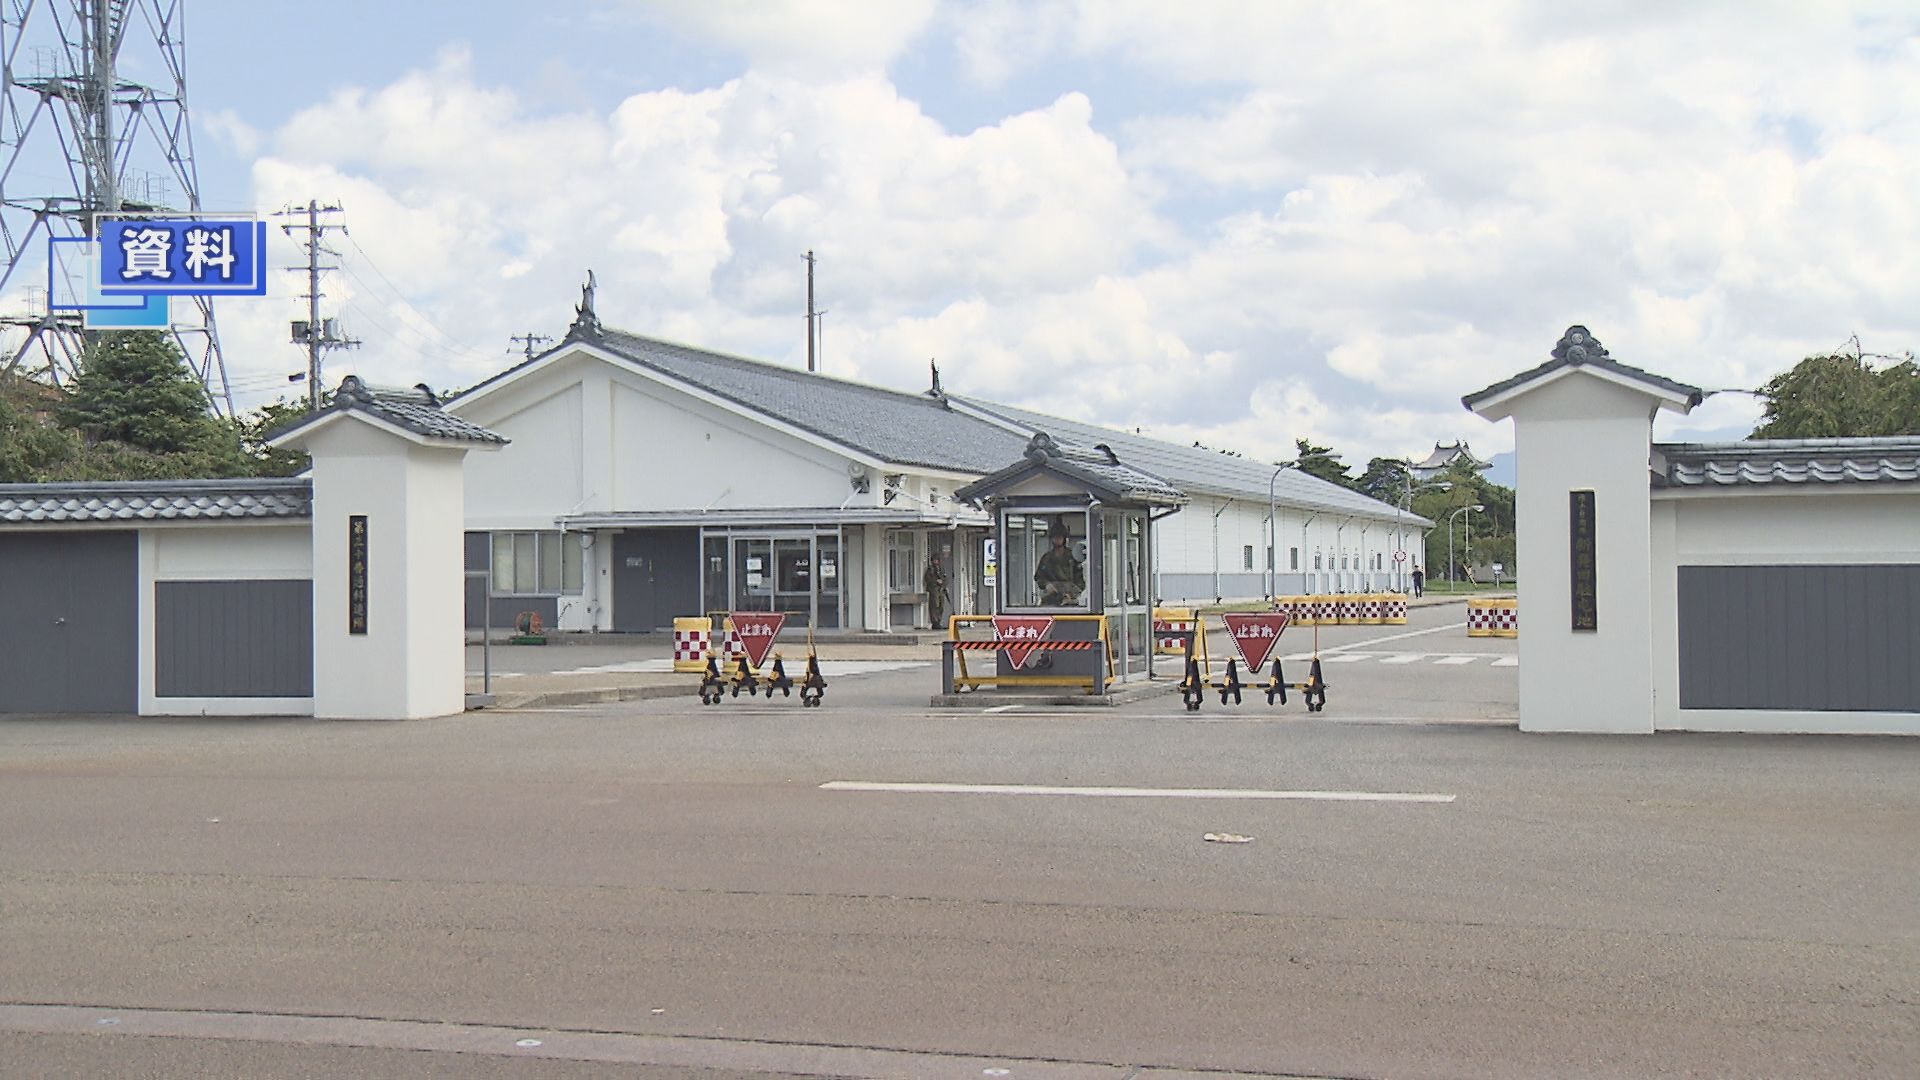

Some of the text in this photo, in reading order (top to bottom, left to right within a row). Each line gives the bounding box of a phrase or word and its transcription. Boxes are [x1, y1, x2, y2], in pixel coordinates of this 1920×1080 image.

[741, 623, 773, 636] 止まれ
[1002, 625, 1039, 638] 止まれ
[1235, 624, 1276, 638] 止まれ
